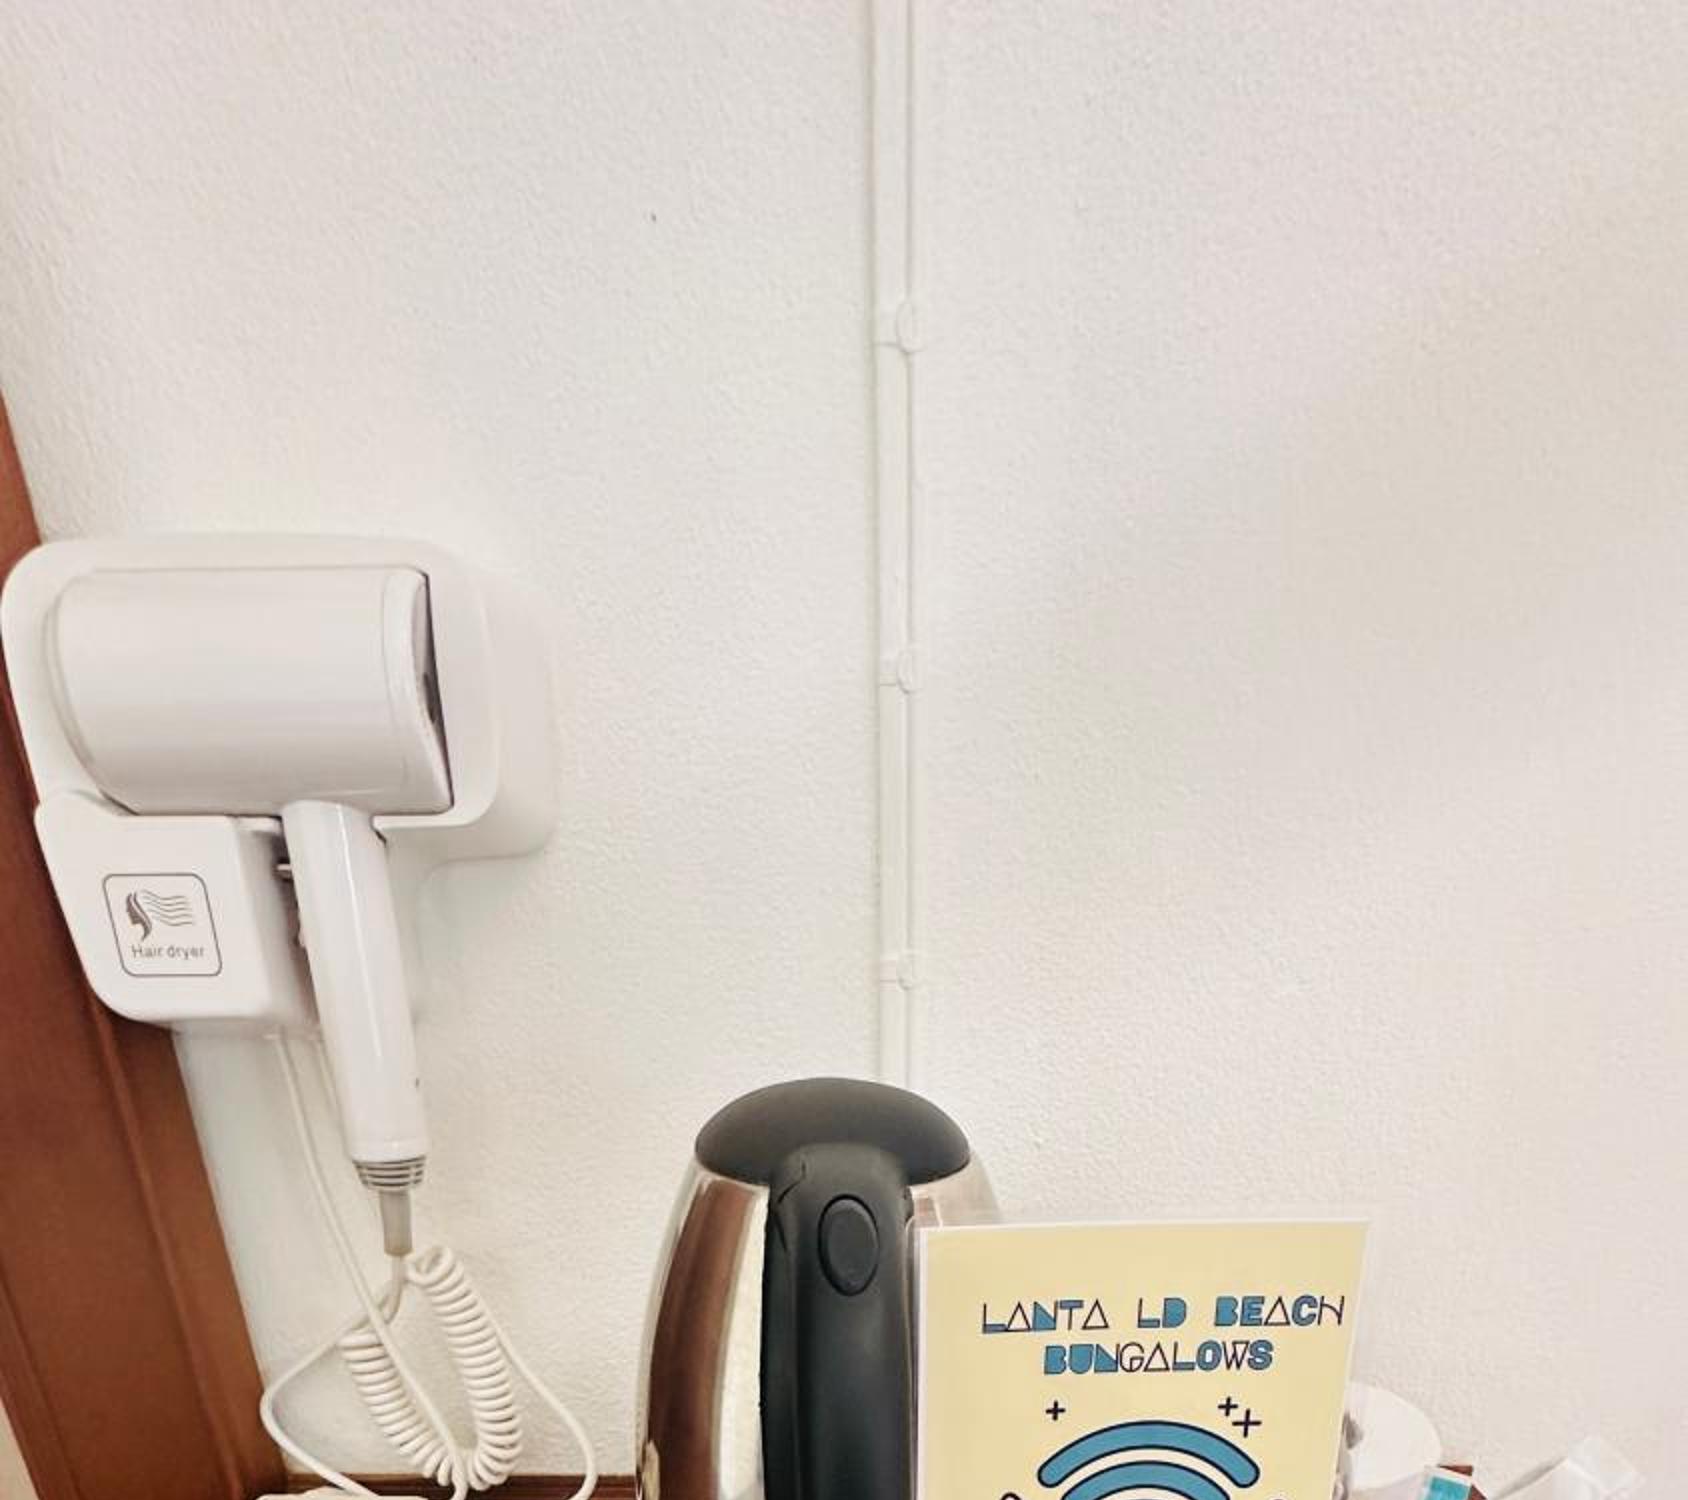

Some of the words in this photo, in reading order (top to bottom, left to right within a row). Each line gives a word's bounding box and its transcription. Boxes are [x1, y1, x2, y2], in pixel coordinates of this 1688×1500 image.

[131, 944, 163, 958] Hair
[166, 946, 205, 960] dryer
[982, 1298, 1110, 1334] LANTA
[1137, 1297, 1187, 1328] LD
[1214, 1294, 1345, 1327] BEACH
[1043, 1339, 1274, 1375] BUNGALOWS
